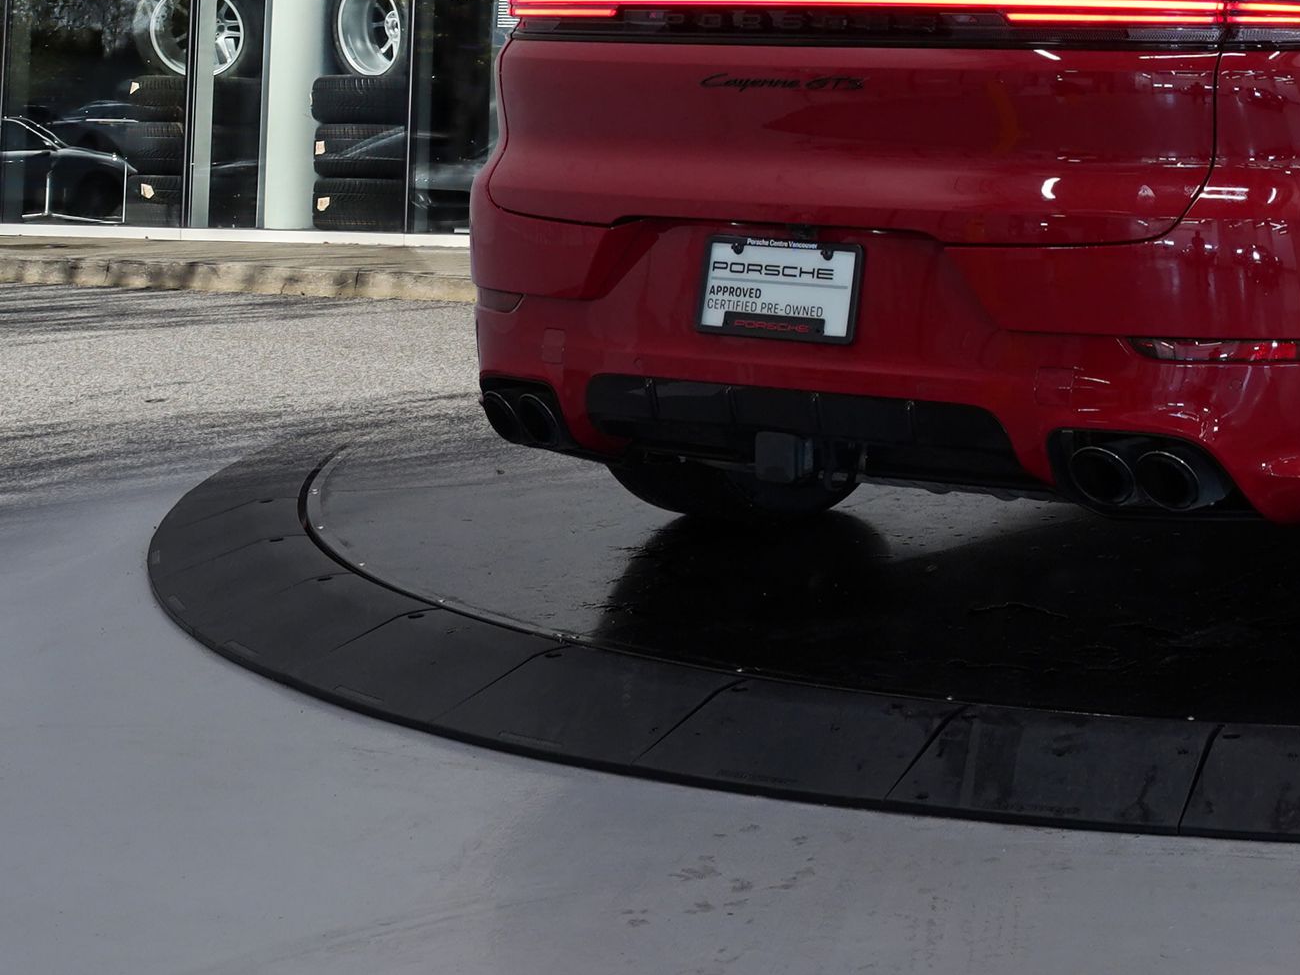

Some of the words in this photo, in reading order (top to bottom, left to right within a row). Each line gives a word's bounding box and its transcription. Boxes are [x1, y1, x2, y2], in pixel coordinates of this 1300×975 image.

[700, 73, 800, 92] Cayenne
[806, 77, 866, 90] GTS
[747, 238, 769, 247] Porsche
[770, 240, 788, 248] Centre
[788, 240, 818, 249] Vancouver
[712, 261, 835, 280] PORSCHE
[709, 285, 762, 299] APPROVED
[707, 298, 757, 313] CERTIFIED
[760, 302, 823, 317] PRE-OWNED
[734, 320, 810, 332] PORSCHE
